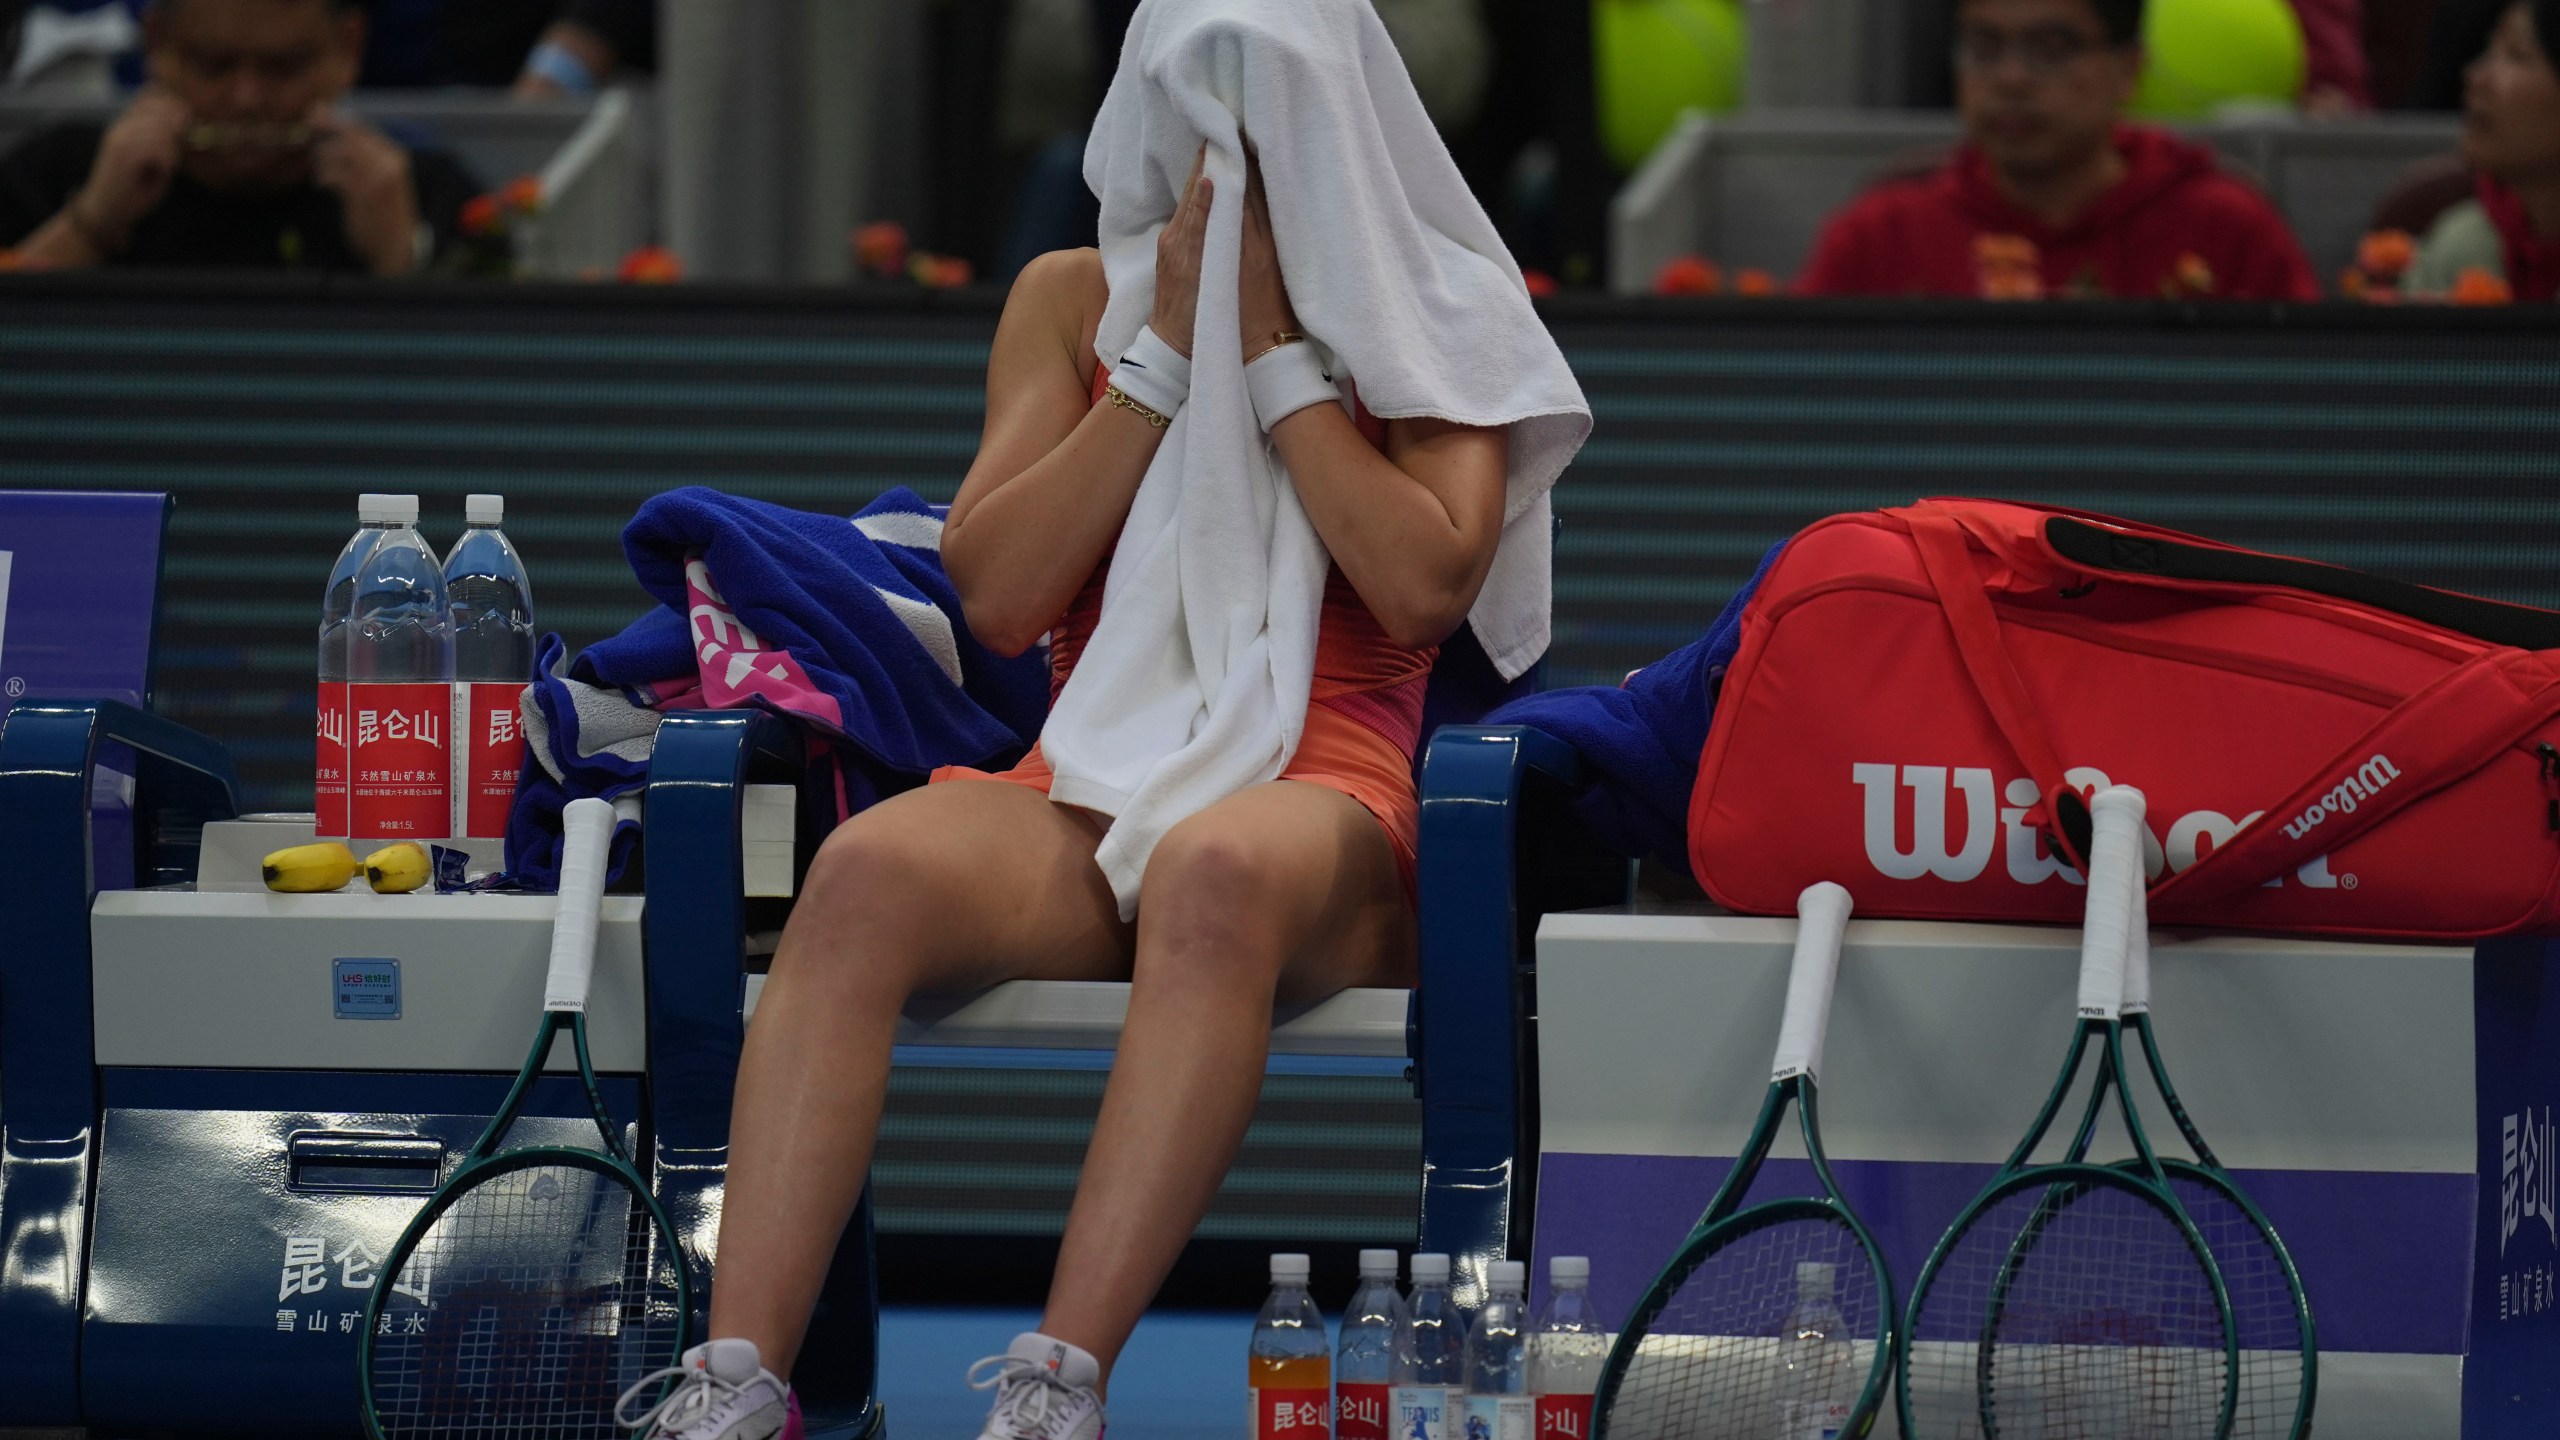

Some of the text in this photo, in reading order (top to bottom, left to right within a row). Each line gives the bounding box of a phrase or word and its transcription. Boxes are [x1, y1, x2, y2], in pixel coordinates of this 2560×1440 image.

[358, 708, 439, 748] 昆仑山
[360, 770, 437, 781] 天然雪山矿泉水
[2283, 753, 2402, 840] Wilson
[342, 974, 363, 983] UHS
[2501, 1105, 2555, 1260] 昆仑山
[278, 1237, 433, 1307] 昆仑山
[2500, 1260, 2554, 1322] 雪山矿泉水
